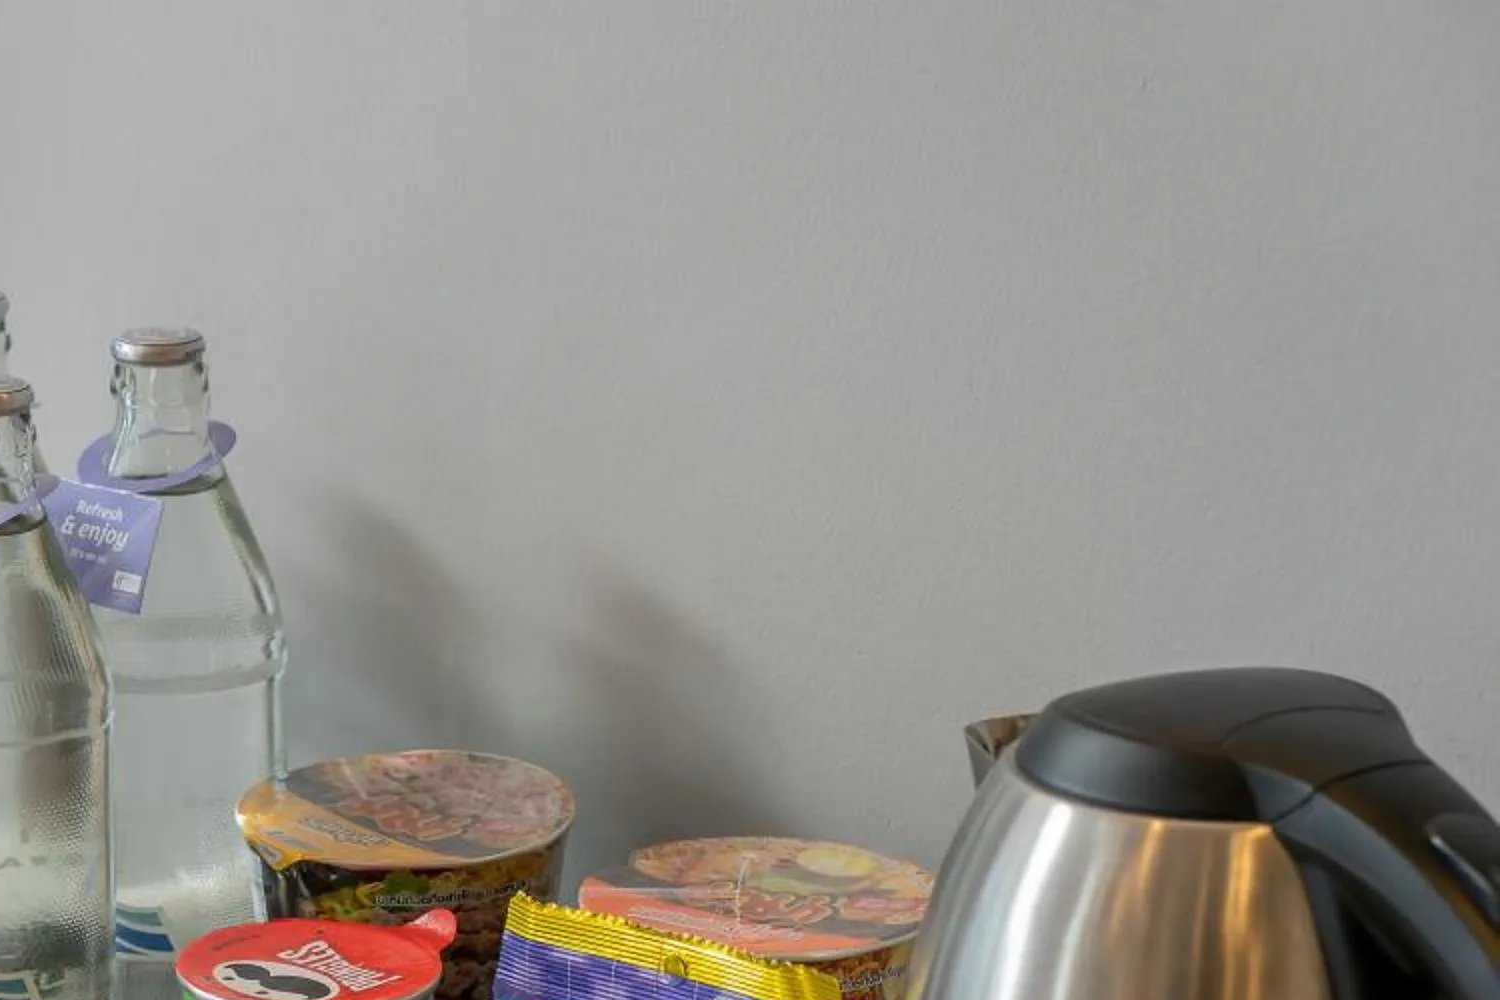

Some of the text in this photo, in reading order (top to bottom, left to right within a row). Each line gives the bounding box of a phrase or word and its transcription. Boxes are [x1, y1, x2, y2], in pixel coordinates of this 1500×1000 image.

[76, 499, 123, 521] Refresh
[60, 514, 129, 552] & enjoy
